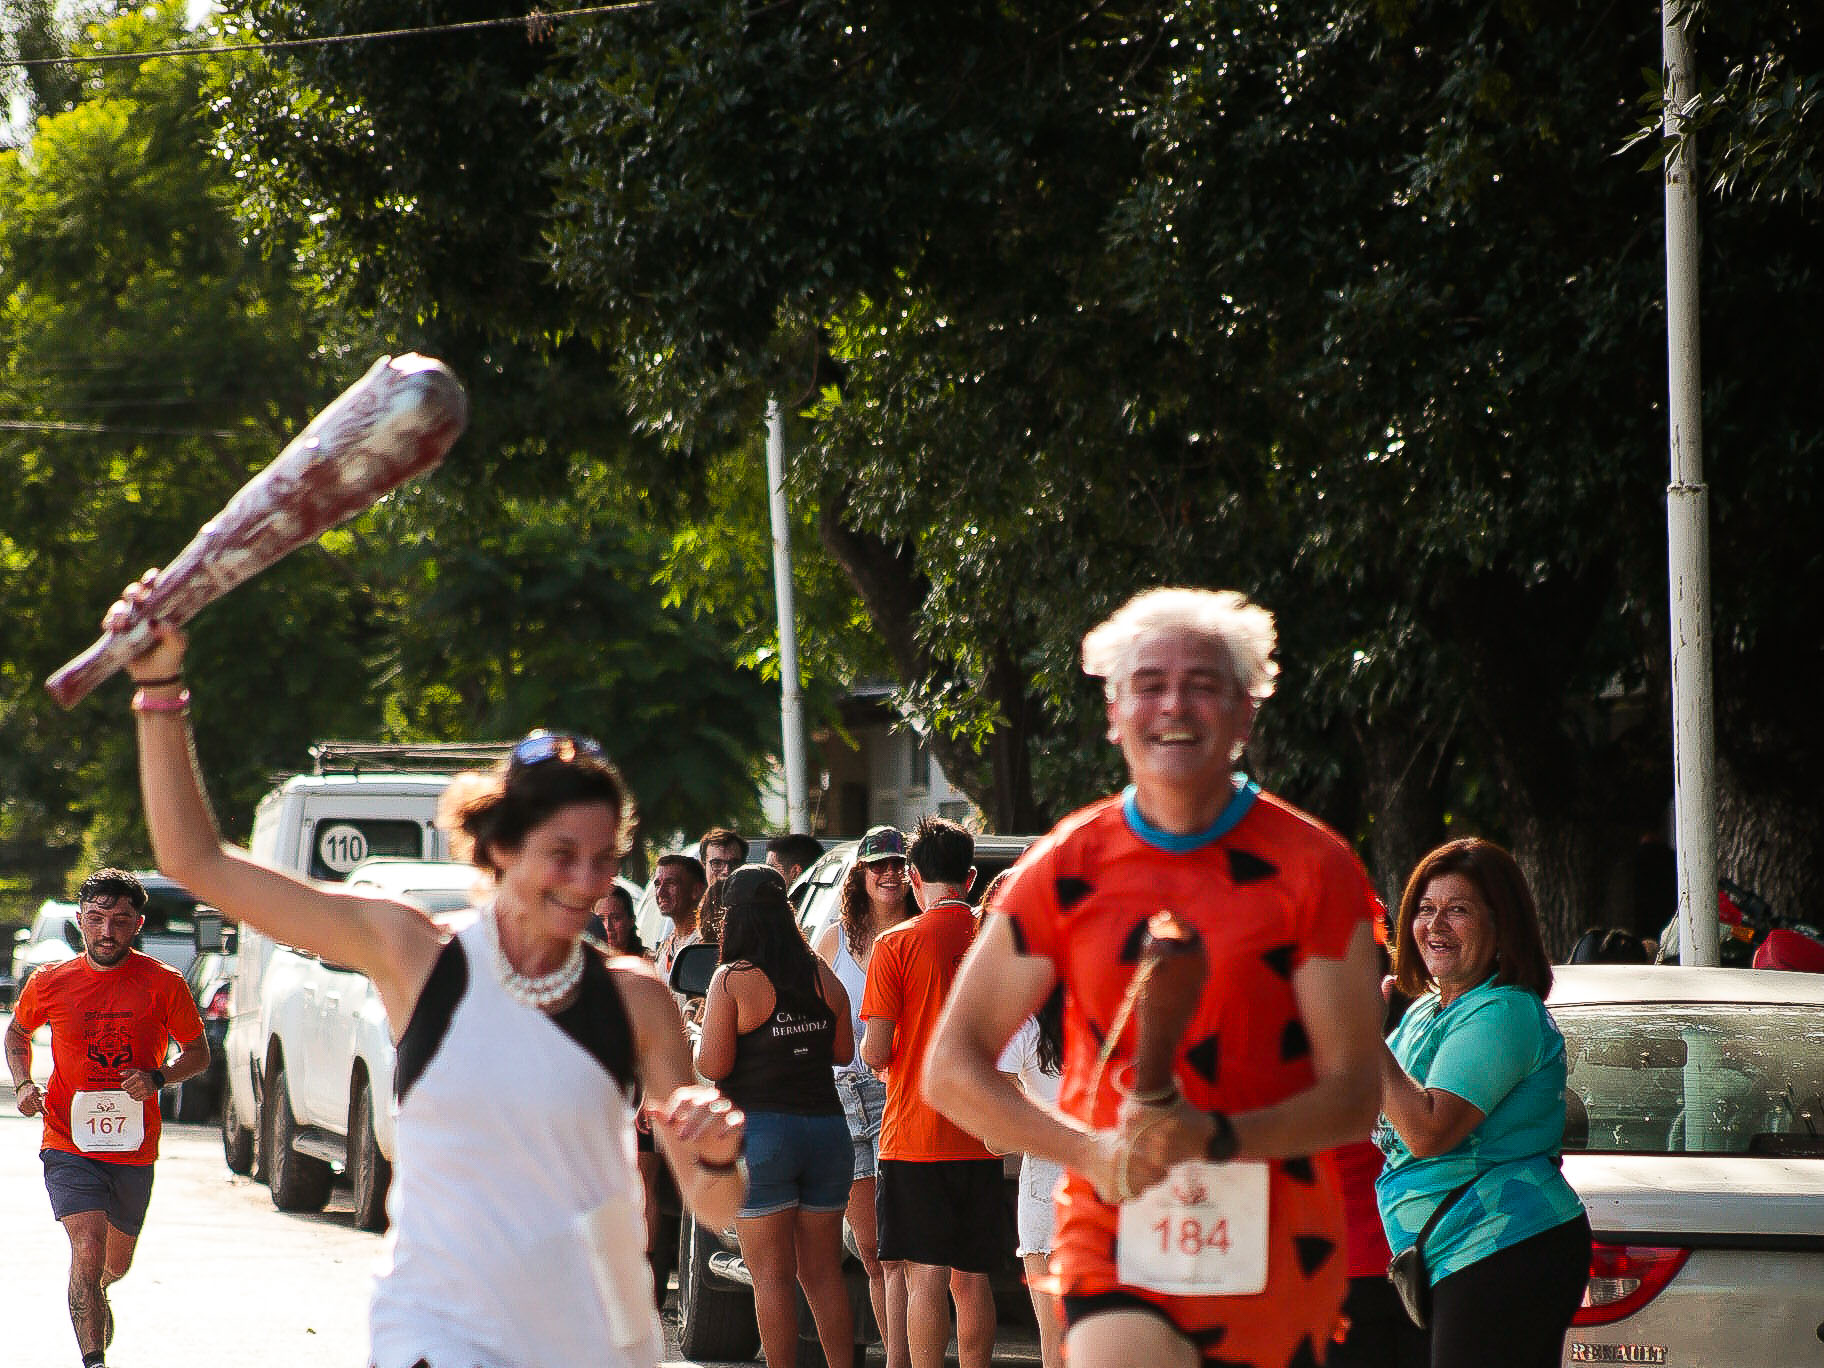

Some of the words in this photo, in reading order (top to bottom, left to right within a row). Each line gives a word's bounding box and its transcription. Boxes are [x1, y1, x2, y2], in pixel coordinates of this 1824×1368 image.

[328, 836, 361, 861] 110
[86, 1116, 127, 1134] 167
[1151, 1216, 1230, 1255] 184
[1572, 1343, 1667, 1364] RENAULT
